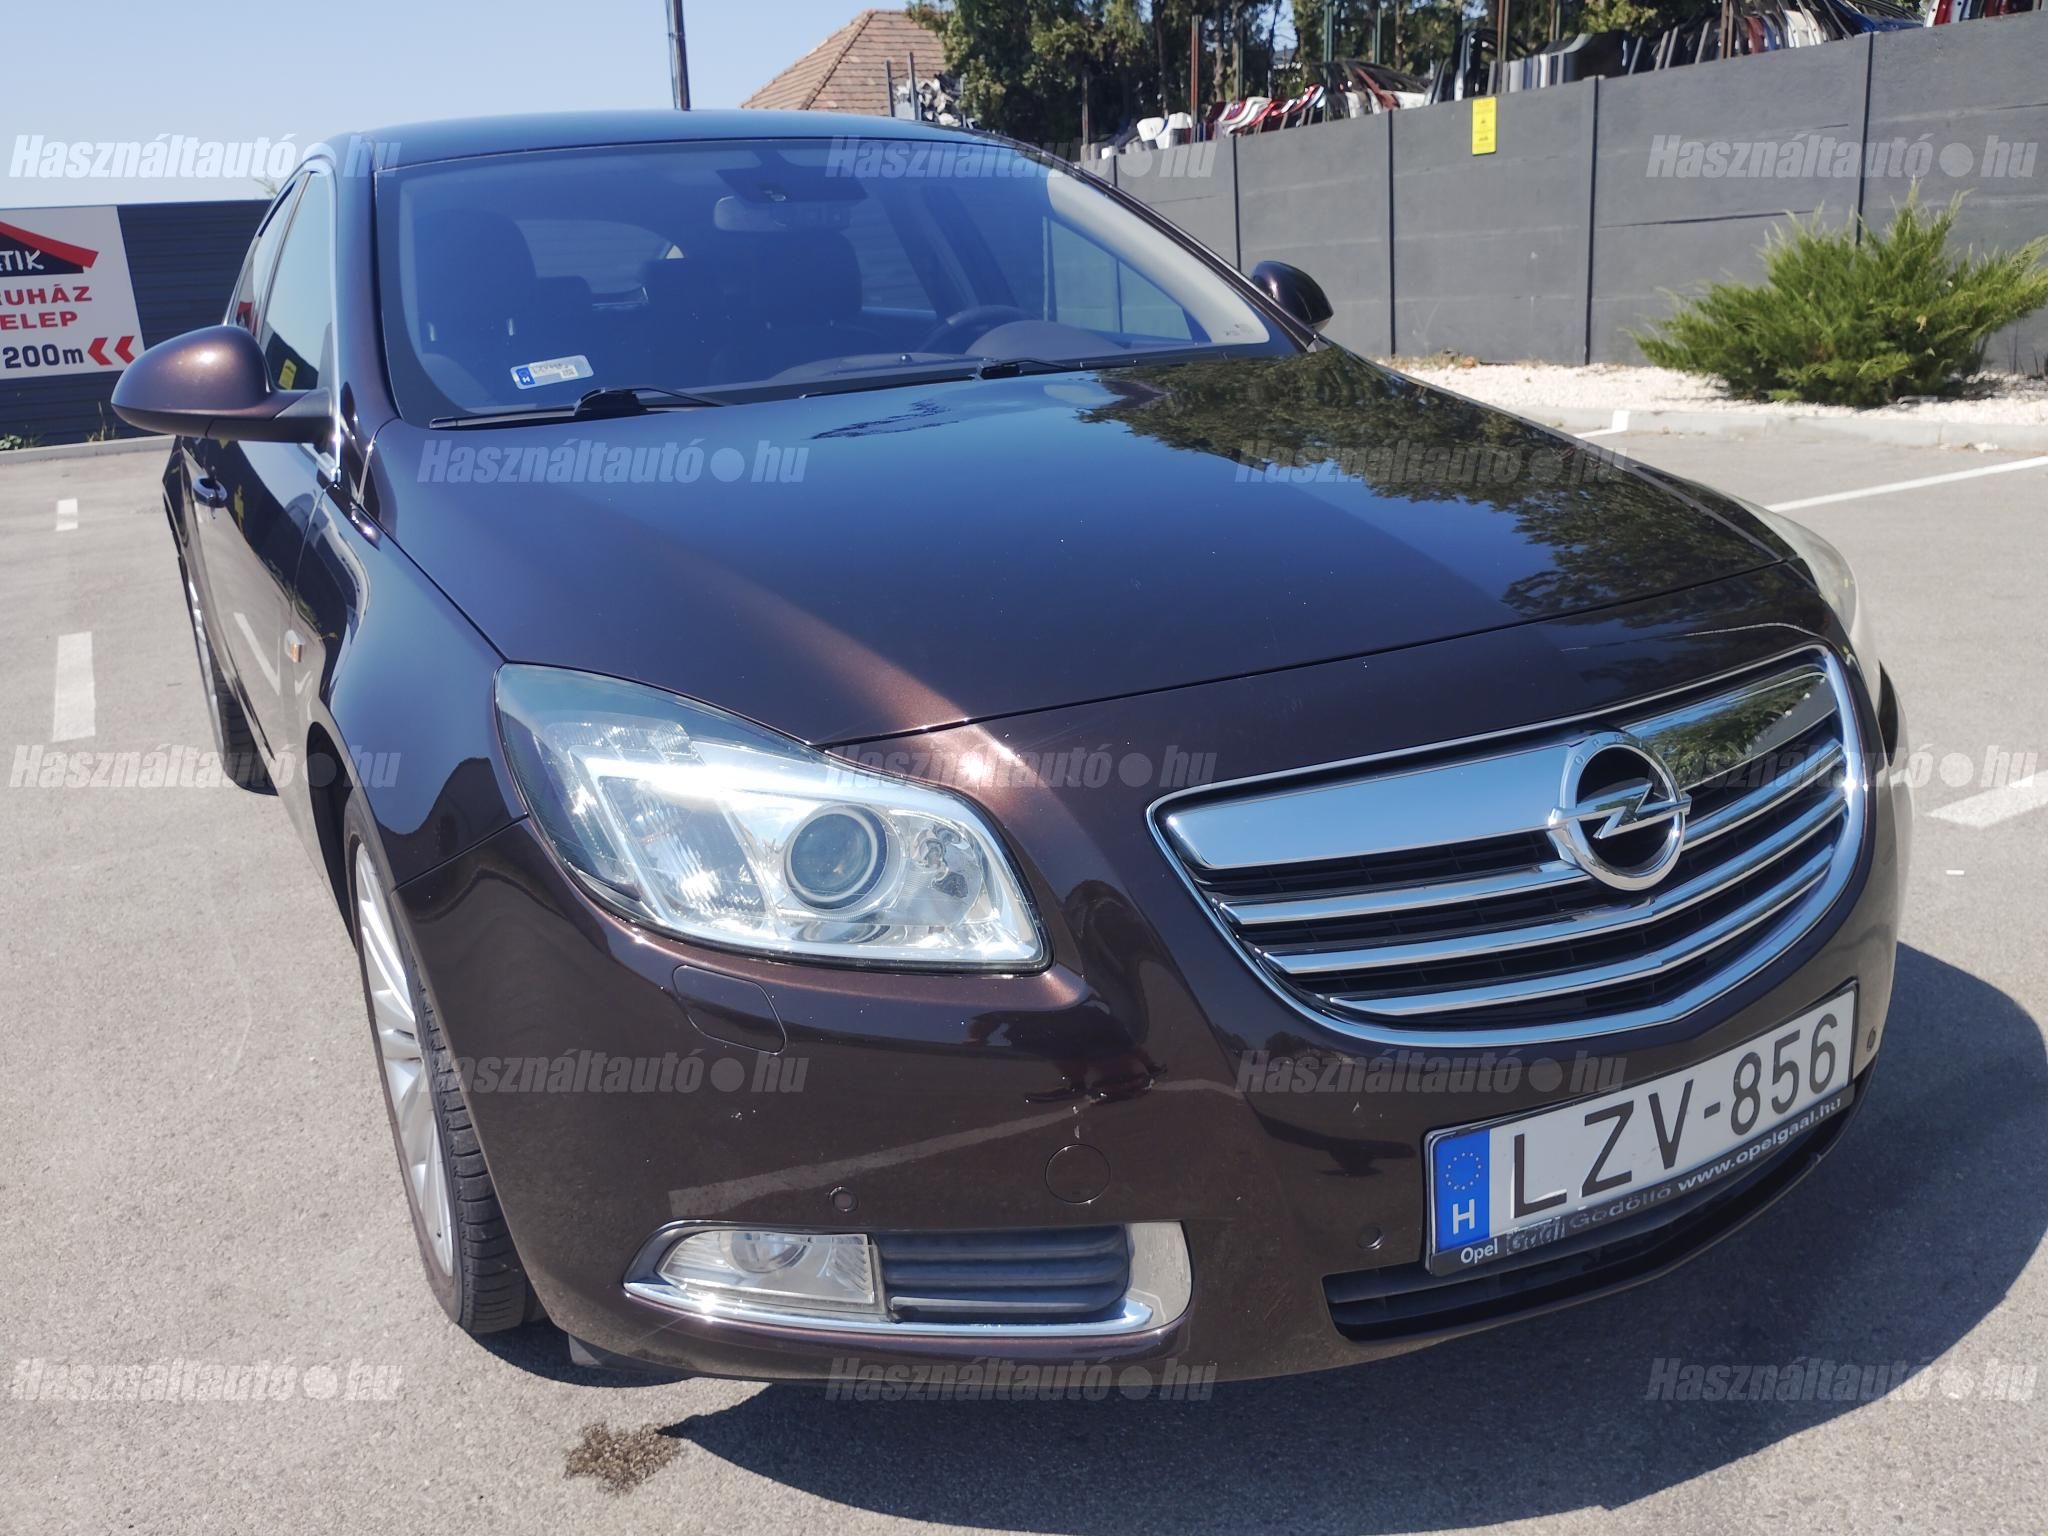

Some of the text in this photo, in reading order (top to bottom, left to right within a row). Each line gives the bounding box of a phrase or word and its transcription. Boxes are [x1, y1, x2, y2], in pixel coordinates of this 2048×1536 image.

[0, 249, 45, 272] TIK
[0, 283, 93, 307] UHÁZ
[2, 344, 85, 369] 200m
[1512, 1013, 1838, 1219] LZV-856
[1452, 1198, 1476, 1235] H
[1460, 1238, 1499, 1264] Opel
